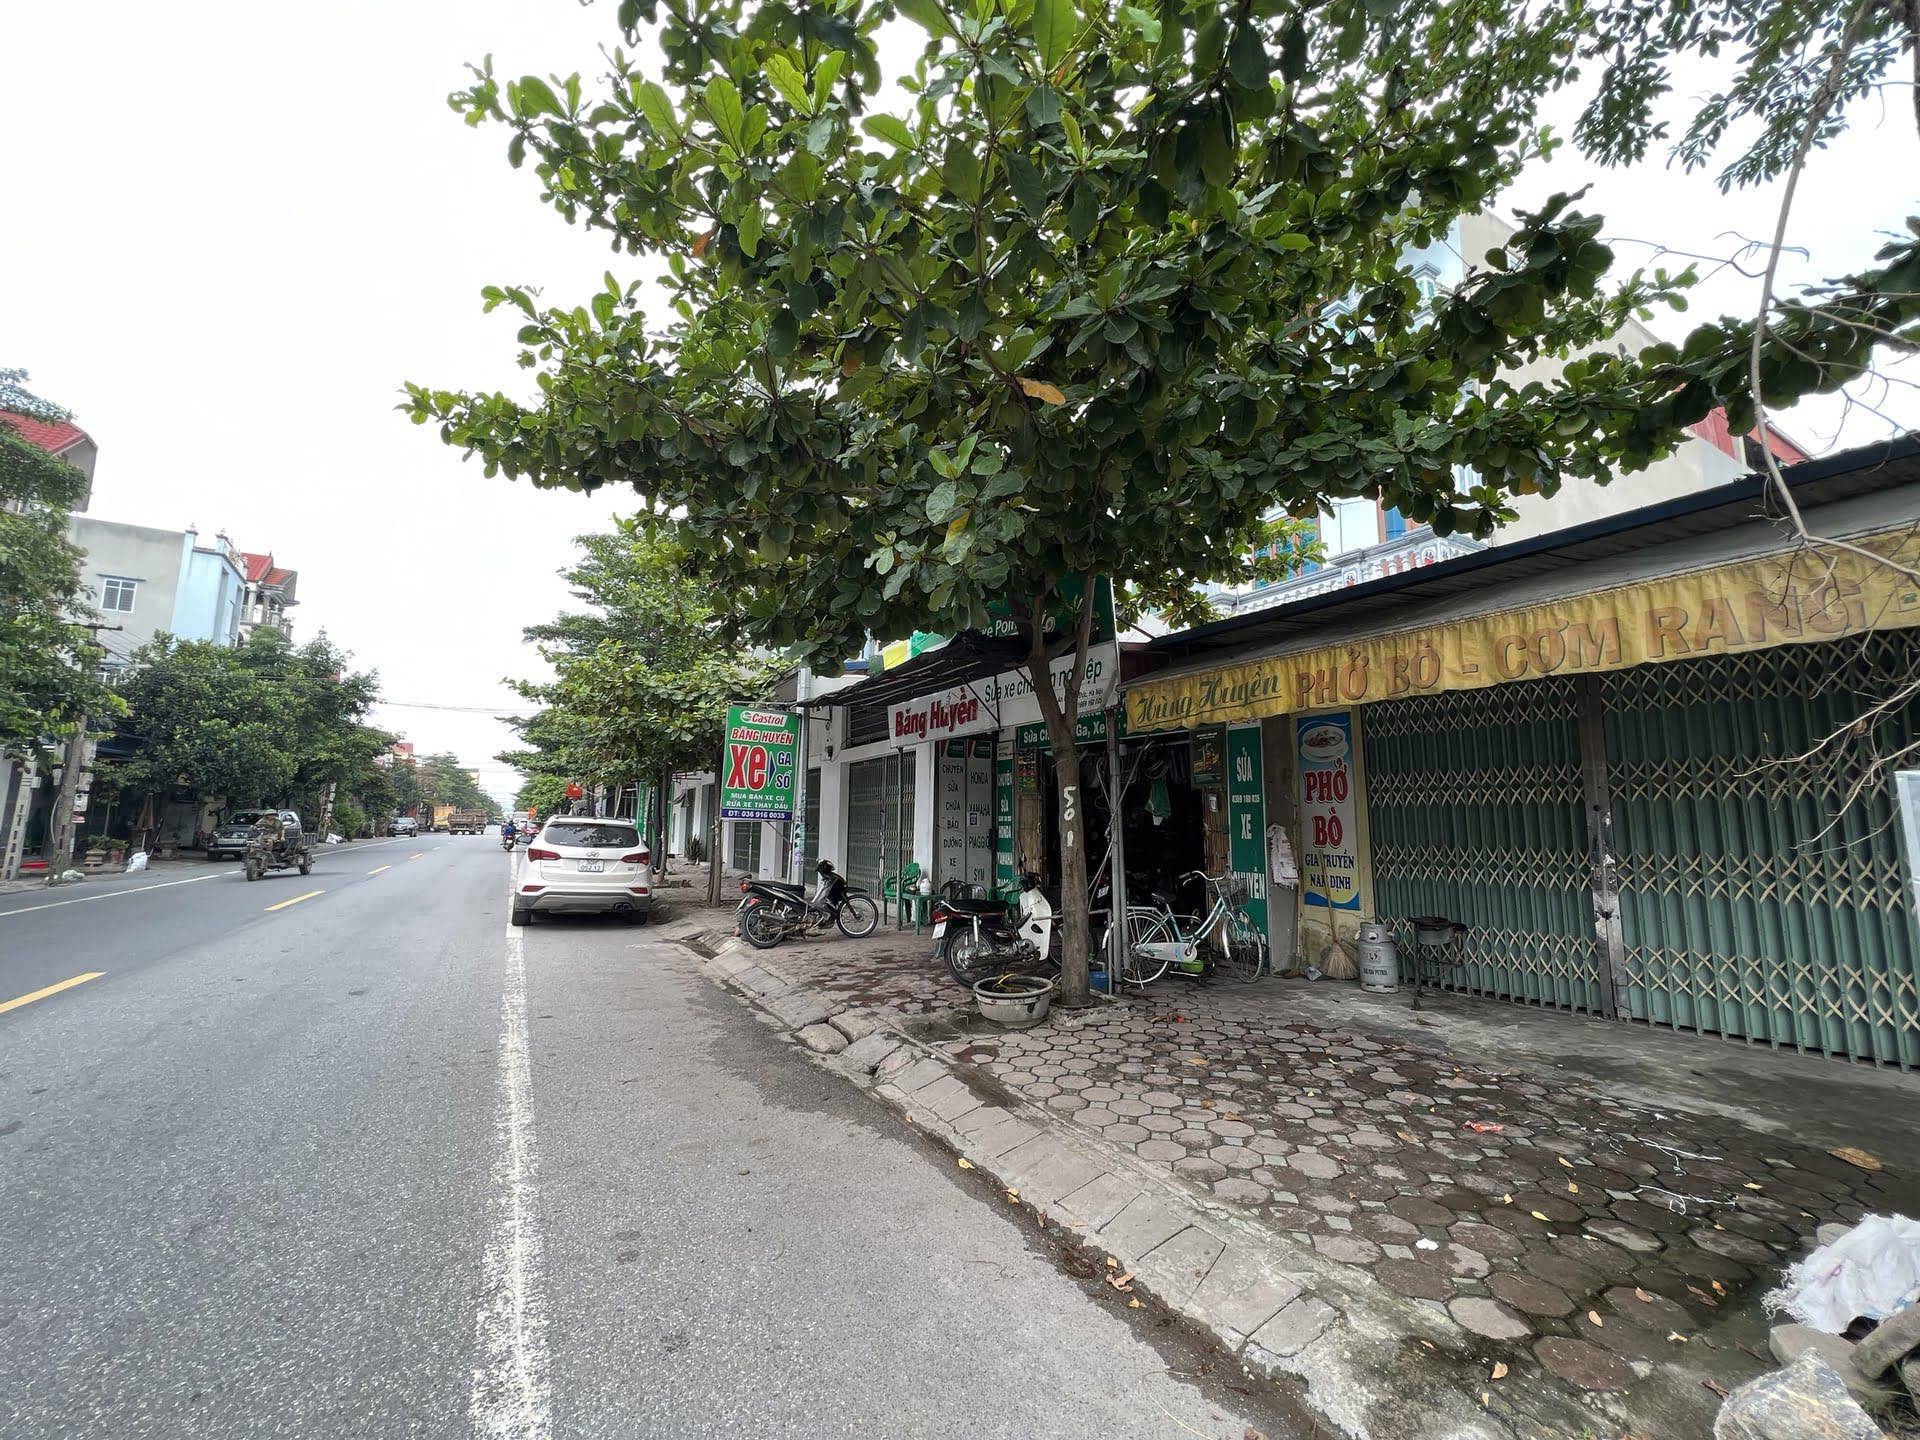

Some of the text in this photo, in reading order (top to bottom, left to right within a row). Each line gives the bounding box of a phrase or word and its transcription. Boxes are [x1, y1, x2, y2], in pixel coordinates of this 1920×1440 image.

[1296, 648, 1370, 707] PHỞ
[1494, 616, 1622, 680] CƠM
[1644, 577, 1867, 659] RANG
[1004, 682, 1015, 698] xe
[751, 712, 786, 726] Castrol
[1093, 720, 1106, 735] Xe
[777, 750, 792, 767] GA
[1236, 746, 1253, 782] SỬA
[1304, 757, 1349, 803] PHỞ
[1240, 813, 1252, 839] XE
[1312, 806, 1344, 849] BÒ
[1305, 853, 1319, 867] GIA
[1329, 874, 1351, 893] ĐỊNH
